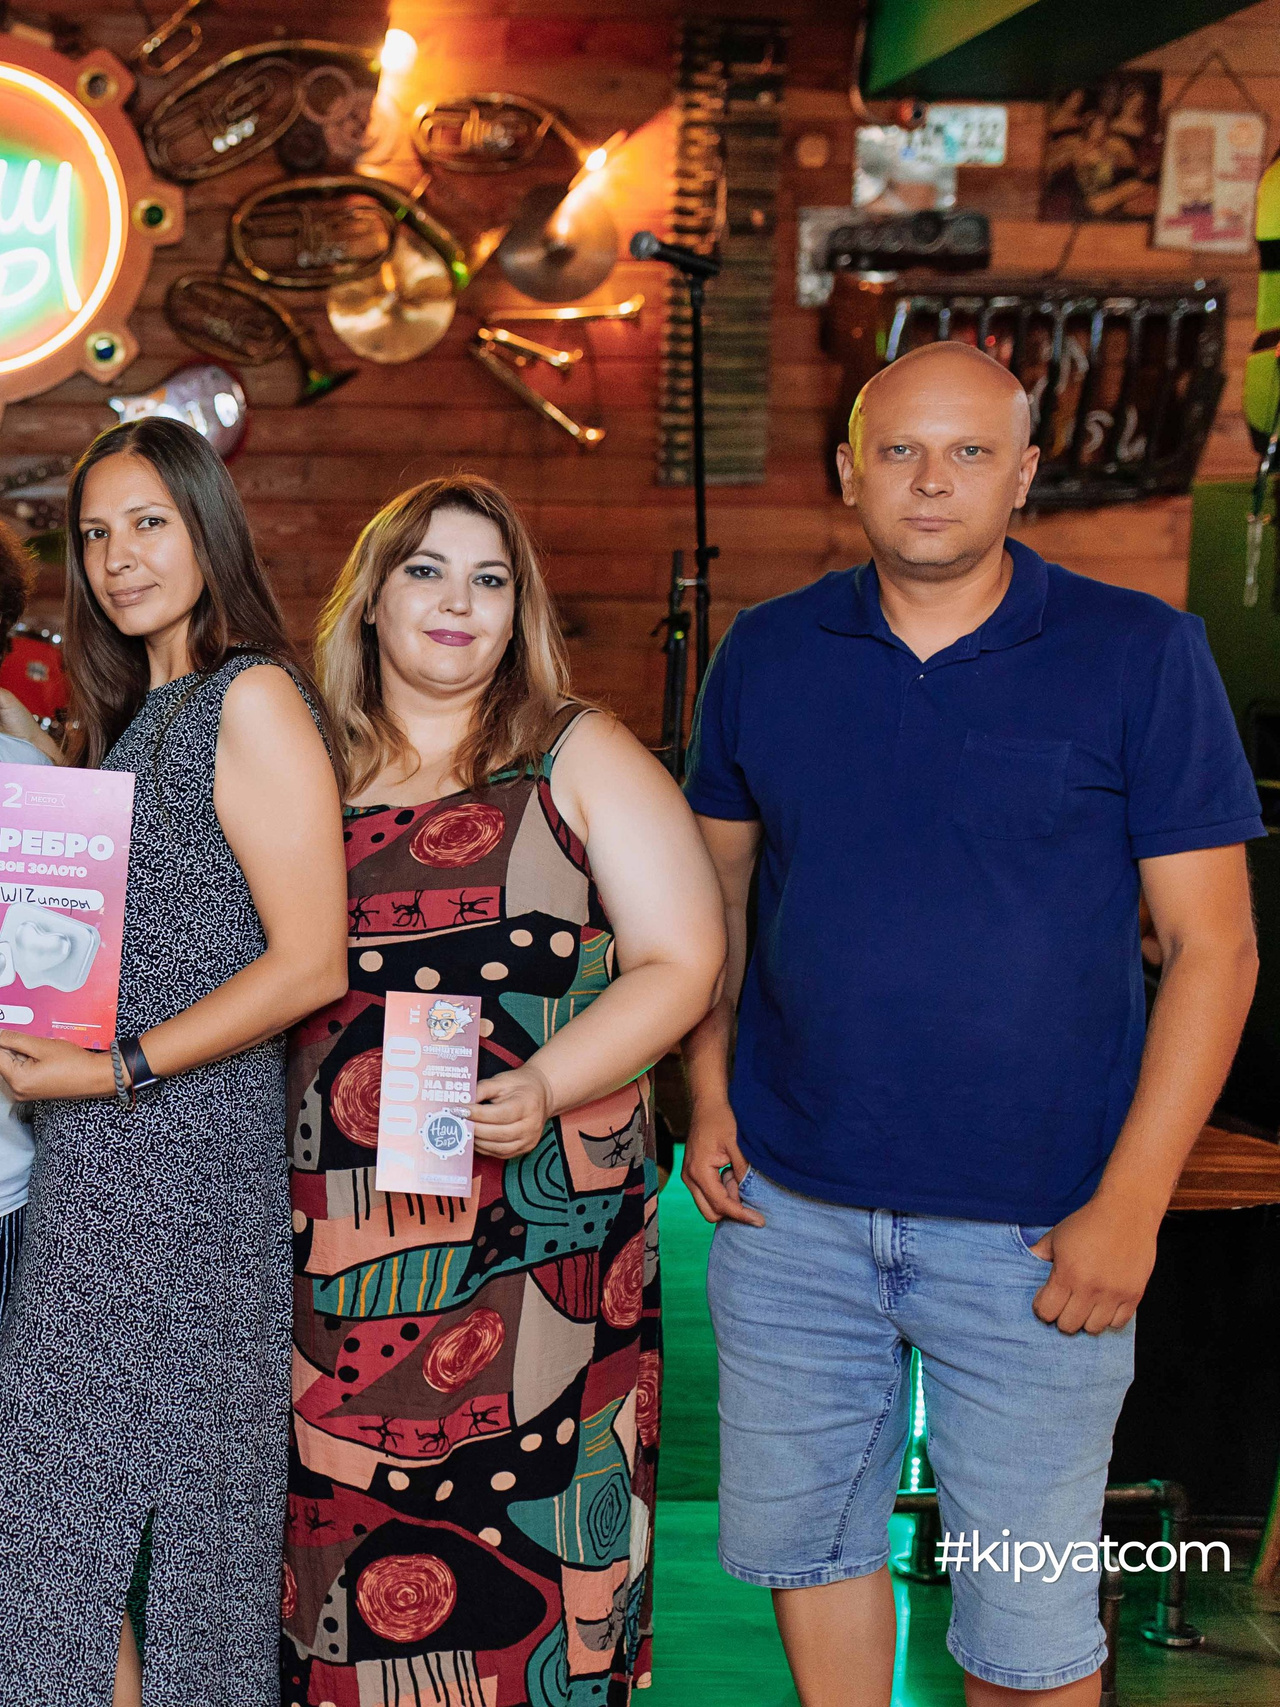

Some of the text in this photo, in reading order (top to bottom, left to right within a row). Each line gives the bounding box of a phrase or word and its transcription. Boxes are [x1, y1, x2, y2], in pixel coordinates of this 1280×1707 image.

[2, 782, 58, 808] 2 МЕСТО
[27, 862, 88, 878] ЗОЛОТО
[424, 1080, 470, 1091] НА ВСЕ
[421, 1089, 472, 1104] МЕНЮ
